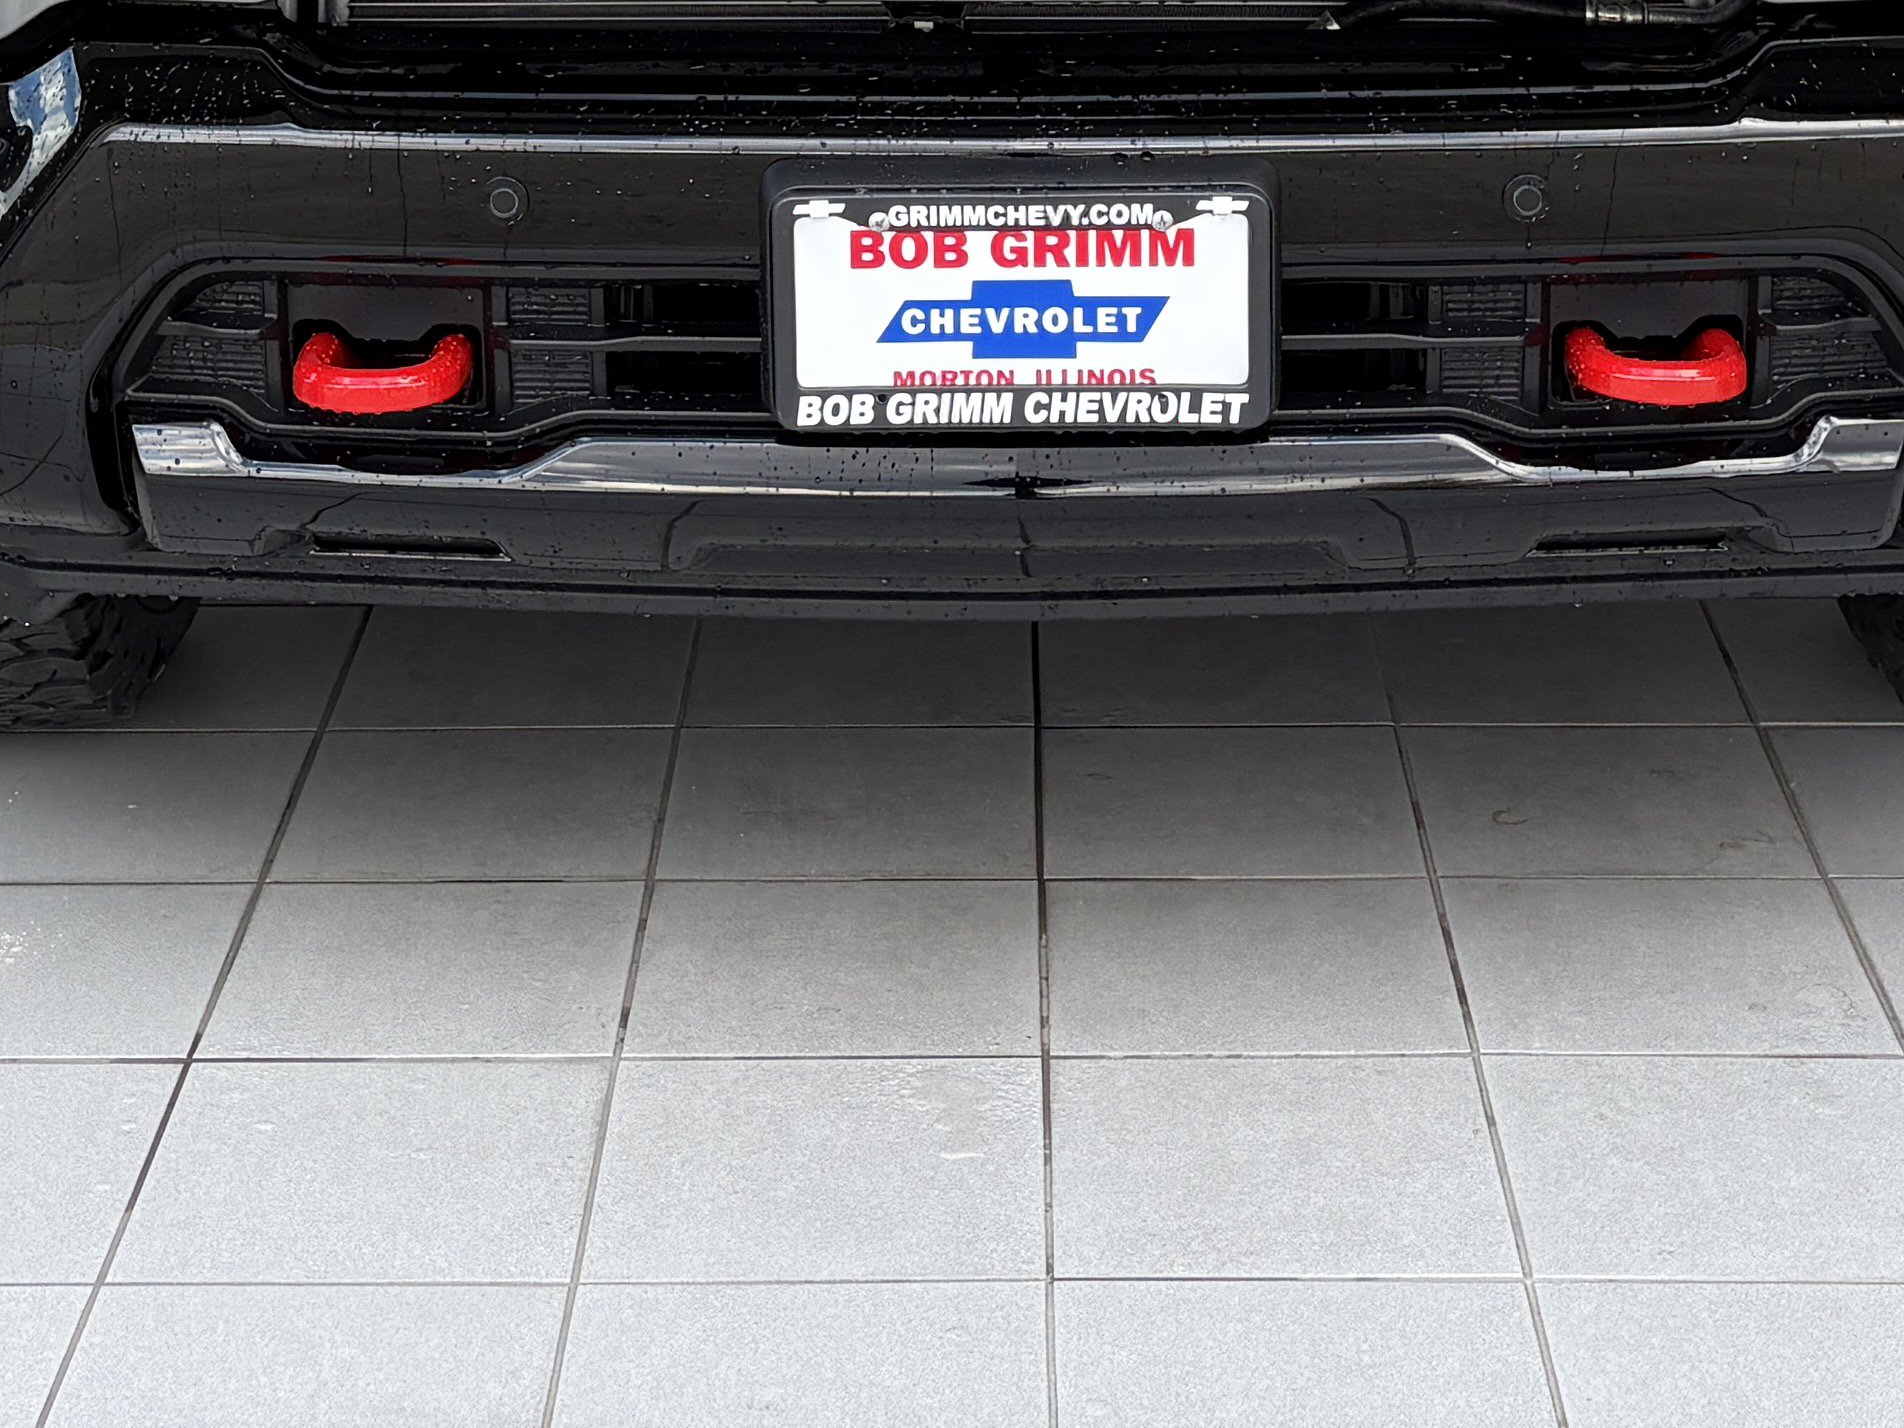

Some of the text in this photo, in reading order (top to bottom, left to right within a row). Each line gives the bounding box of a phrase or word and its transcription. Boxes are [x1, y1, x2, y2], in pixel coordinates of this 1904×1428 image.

[887, 203, 1154, 227] GRIMMCHEVY.COM
[850, 228, 1195, 269] BOB GRIMM
[901, 306, 1143, 335] CHEVROLET
[893, 369, 1015, 386] MORTON
[796, 391, 1250, 426] BOB GRIMM CHEVROLET
